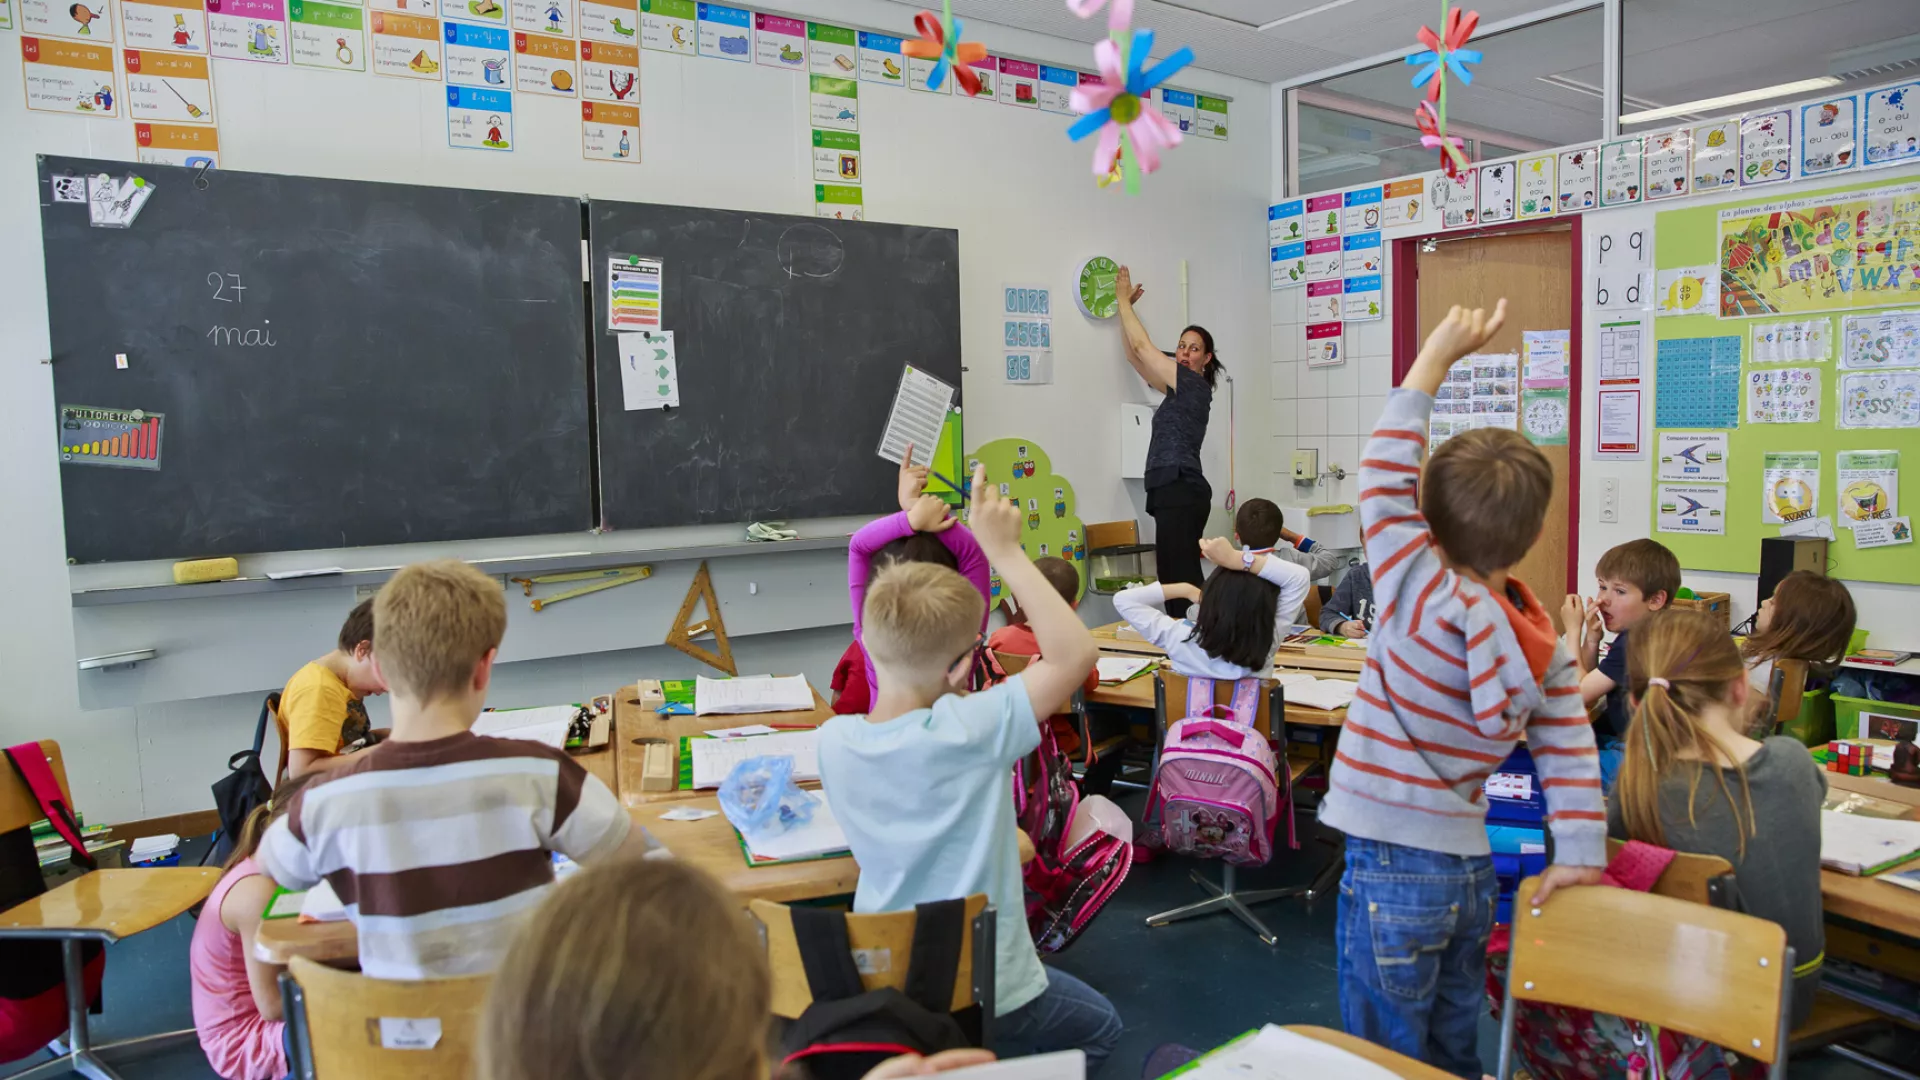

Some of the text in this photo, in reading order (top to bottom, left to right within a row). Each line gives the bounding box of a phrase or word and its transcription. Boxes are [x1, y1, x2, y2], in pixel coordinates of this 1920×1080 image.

[1878, 112, 1909, 125] e eu
[1809, 136, 1822, 144] eu
[1669, 156, 1682, 164] am
[1668, 165, 1682, 173] em
[1580, 176, 1592, 184] om
[1722, 210, 1731, 218] La
[1733, 205, 1760, 217] planète
[1763, 204, 1777, 212] des
[1780, 200, 1806, 212] alphas
[1600, 232, 1642, 264] p q
[1100, 258, 1106, 268] 12
[206, 272, 247, 303] 27
[1597, 274, 1640, 305] b d
[1007, 290, 1016, 312] 0
[1020, 290, 1027, 312] 1
[1030, 290, 1038, 312] 2
[206, 320, 277, 346] mai
[1006, 324, 1018, 345] 4
[1018, 324, 1028, 346] 5
[1008, 358, 1030, 379] 8 9
[1784, 508, 1814, 523] AVANT
[1185, 769, 1228, 784] MINNIE
